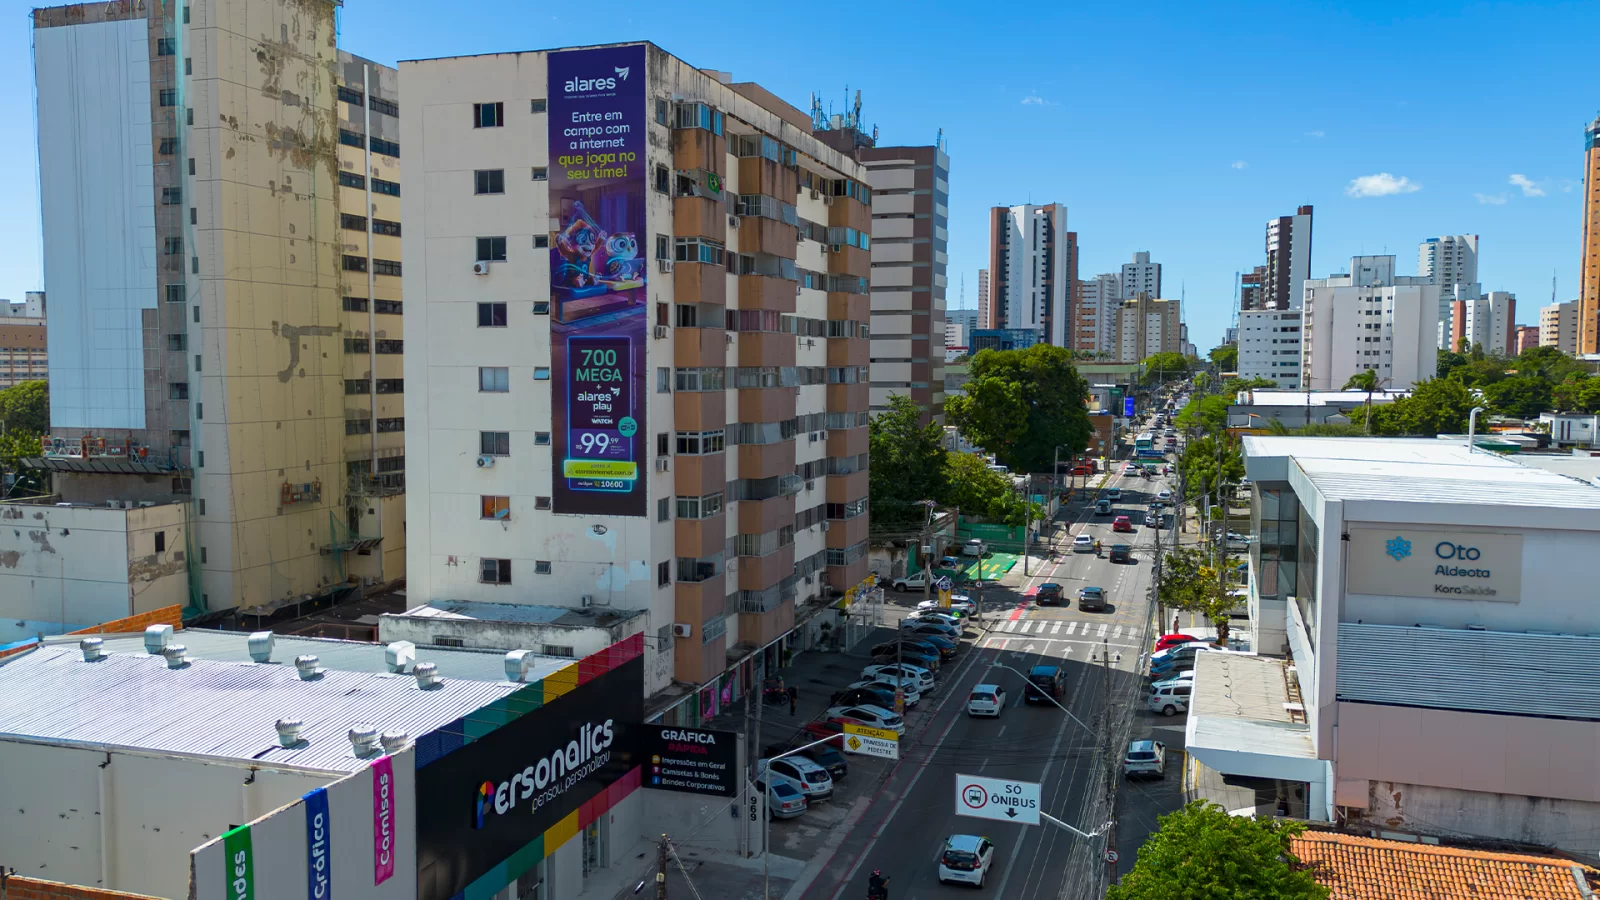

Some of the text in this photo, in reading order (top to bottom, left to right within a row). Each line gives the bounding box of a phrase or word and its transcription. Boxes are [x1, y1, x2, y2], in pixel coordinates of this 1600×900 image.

[564, 76, 616, 92] alares
[572, 111, 623, 122] Entre em
[564, 124, 630, 138] campo com
[569, 137, 625, 150] a internet
[558, 151, 636, 168] que joga no
[567, 164, 627, 180] seu time!
[581, 349, 617, 366] 700
[576, 368, 623, 382] MEGA
[577, 391, 612, 401] alares
[592, 401, 613, 413] play
[1435, 541, 1481, 561] Oto
[1434, 564, 1491, 578] Aldeota
[661, 729, 716, 744] GRÁFICA
[856, 728, 885, 738] ATENÇÃO
[863, 738, 889, 748] TRAVESSIA
[867, 746, 892, 756] PEDESTRE
[662, 756, 697, 766] Impressões
[708, 761, 726, 770] Geral
[477, 718, 614, 829] Personalics
[662, 768, 693, 778] Camisetas
[700, 772, 720, 781] Bonés
[531, 751, 611, 815] pensou, personalizou
[662, 777, 726, 791] Brindes Corporativos
[1005, 784, 1022, 794] SÓ
[991, 793, 1036, 809] ÔNIBUS
[380, 773, 390, 866] Camisas
[312, 812, 328, 898] Gráfica
